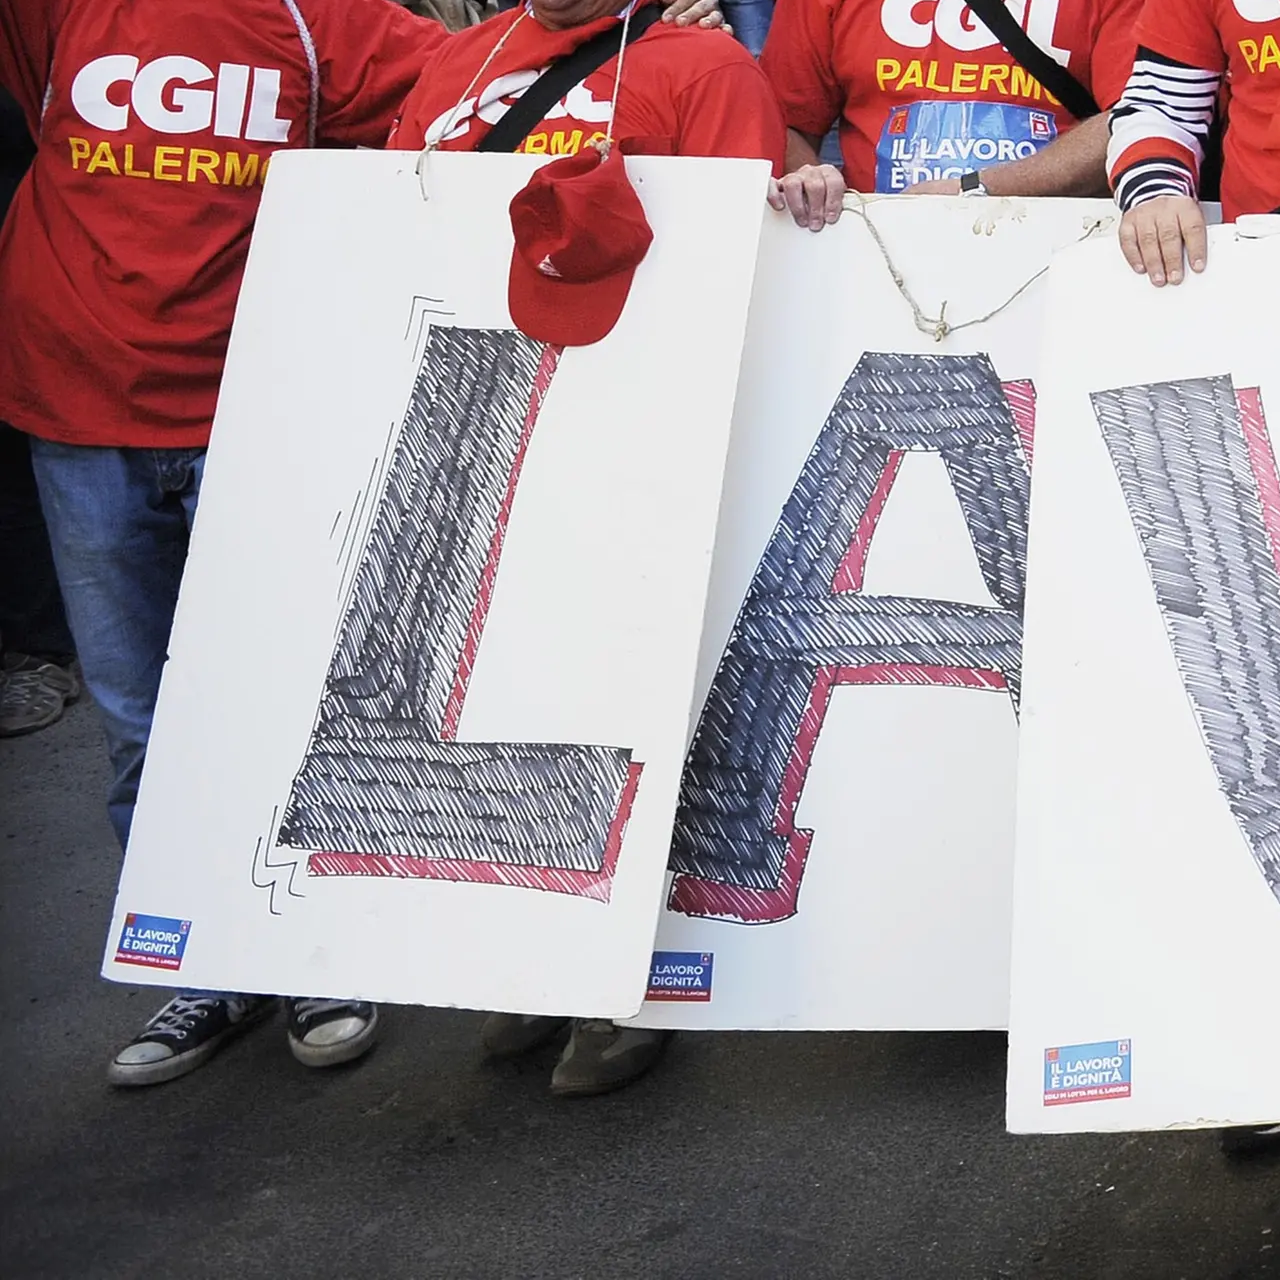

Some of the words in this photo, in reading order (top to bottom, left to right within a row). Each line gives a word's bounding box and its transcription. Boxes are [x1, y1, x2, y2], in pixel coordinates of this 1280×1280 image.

[71, 54, 292, 143] CGIL
[891, 138, 911, 160] IL
[919, 137, 1037, 161] LAVORO
[69, 136, 271, 187] PALERM
[277, 324, 645, 901] L
[668, 349, 1037, 925] A
[126, 926, 136, 938] IL
[138, 928, 181, 944] LAVORO
[122, 937, 131, 949] È
[131, 939, 177, 955] DIGNITÀ
[655, 965, 704, 976] LAVORO
[652, 976, 702, 986] DIGNITÀ
[1051, 1063, 1064, 1075] IL
[1066, 1056, 1123, 1073] LAVORO
[1051, 1074, 1060, 1089] È
[1063, 1068, 1122, 1087] DIGNITÀ
